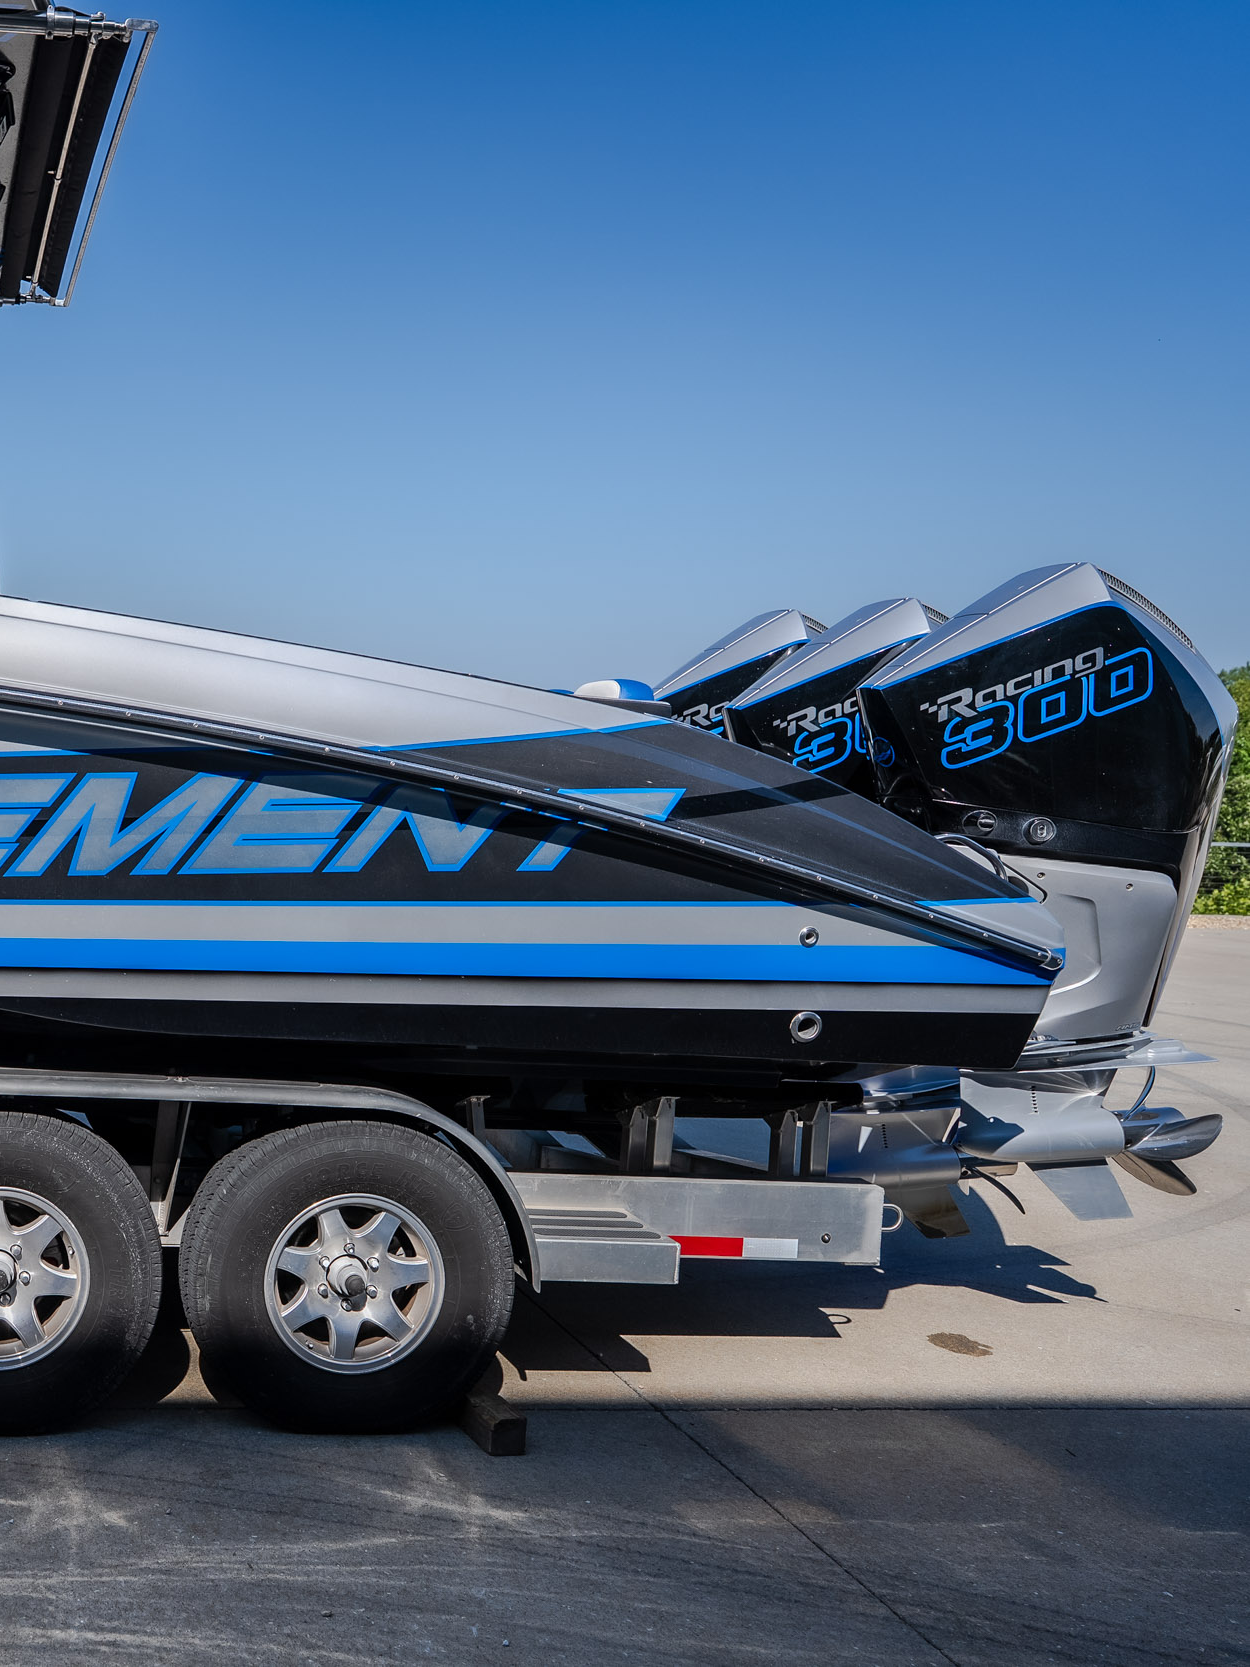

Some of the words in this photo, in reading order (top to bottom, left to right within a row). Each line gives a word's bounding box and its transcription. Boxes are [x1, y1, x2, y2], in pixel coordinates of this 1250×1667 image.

[787, 697, 859, 737] Rac
[935, 647, 1104, 723] Racing
[941, 648, 1154, 770] 300
